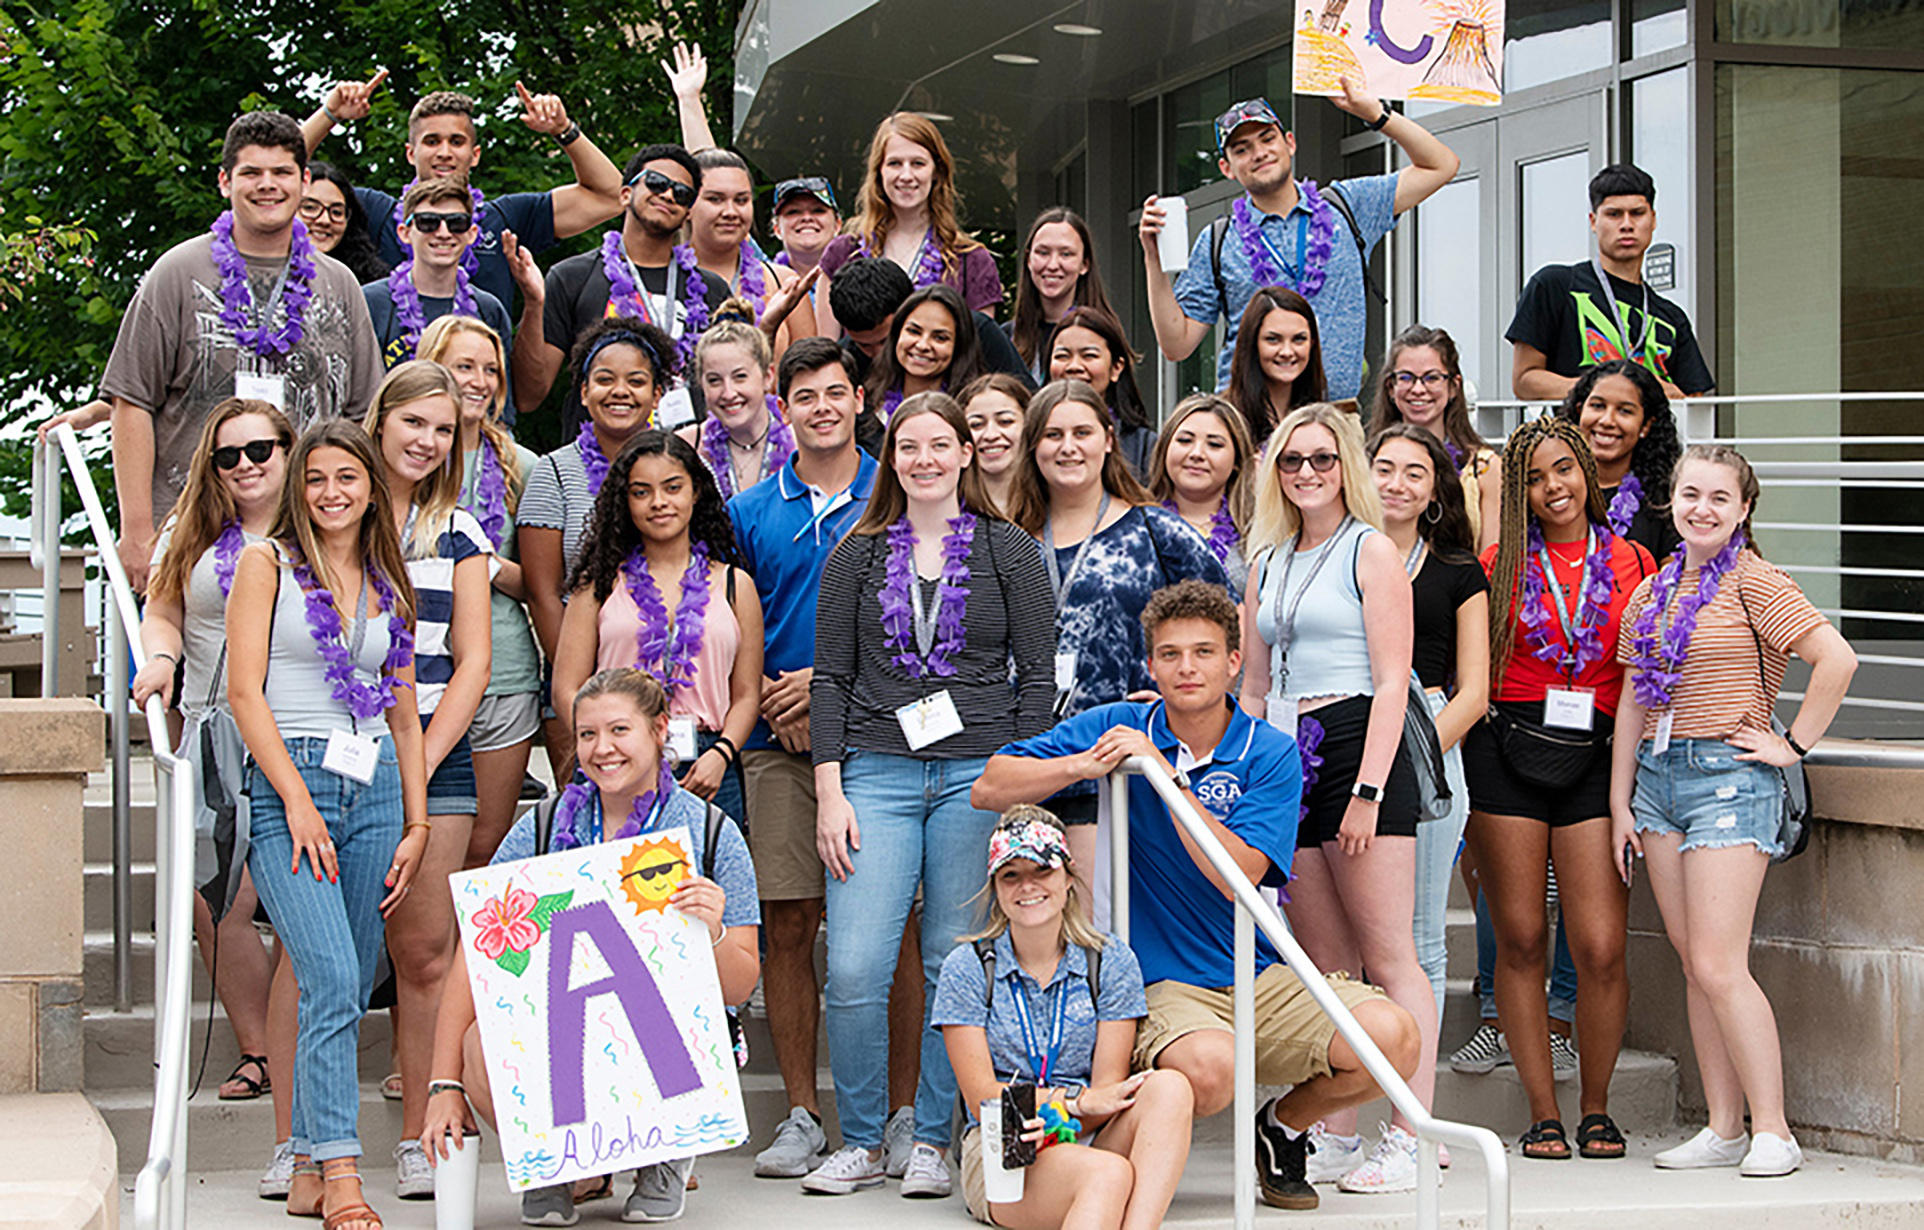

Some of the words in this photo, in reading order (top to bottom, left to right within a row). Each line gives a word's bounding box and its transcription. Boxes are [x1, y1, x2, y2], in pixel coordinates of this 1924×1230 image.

[1197, 783, 1243, 801] SGA
[547, 899, 704, 1128] A
[539, 1115, 683, 1180] Aloha
